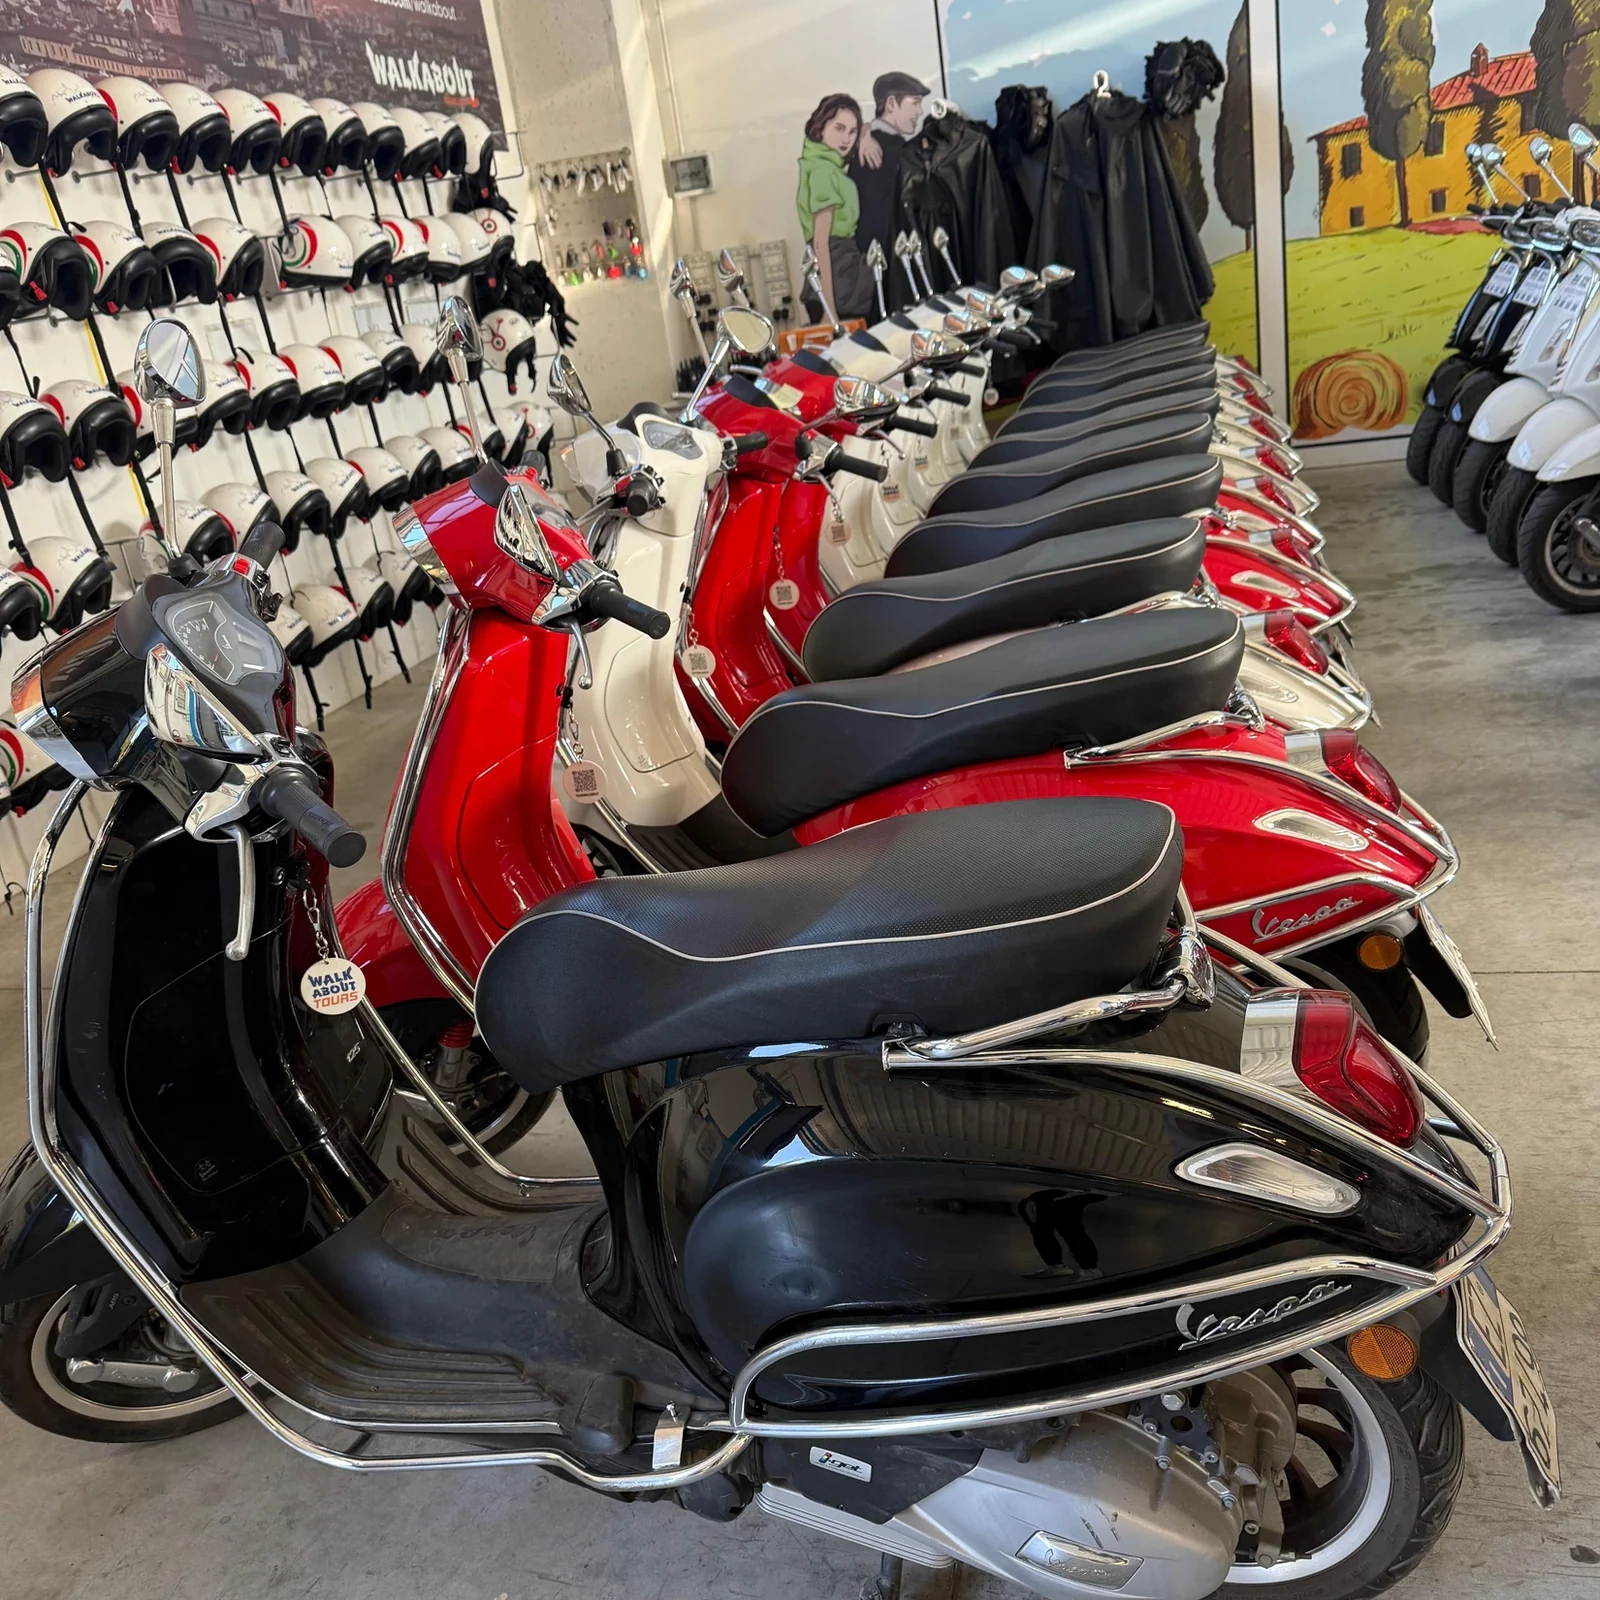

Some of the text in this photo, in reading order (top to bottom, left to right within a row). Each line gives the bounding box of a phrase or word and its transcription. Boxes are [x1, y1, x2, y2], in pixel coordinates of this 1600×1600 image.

[365, 40, 475, 101] WALKABOUT
[1252, 896, 1363, 944] Vespa
[308, 966, 353, 988] WALK
[312, 981, 356, 999] ABOUT
[314, 991, 358, 1009] TOURS
[1175, 1281, 1352, 1351] Vespa
